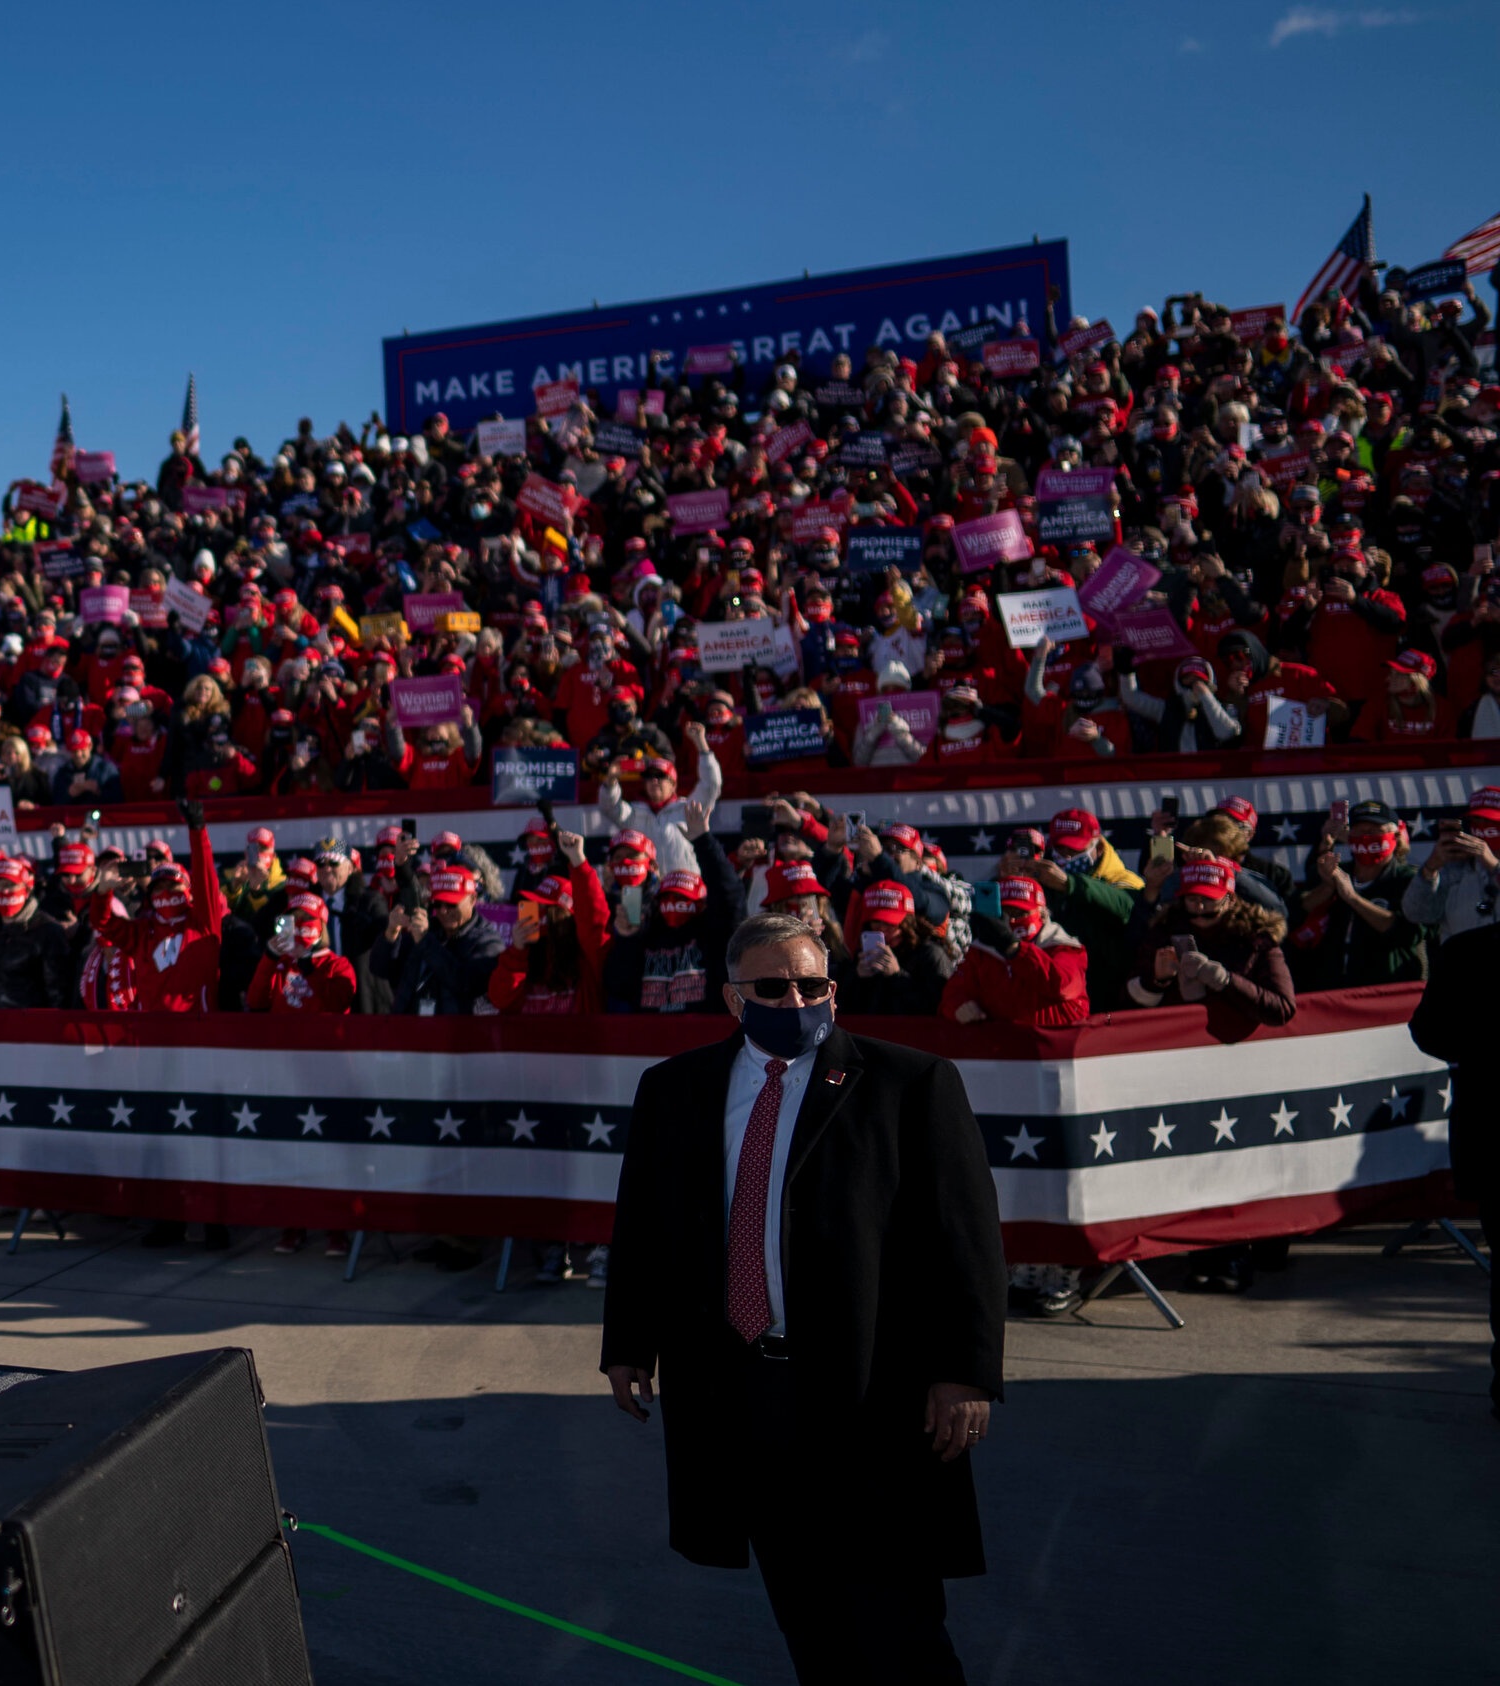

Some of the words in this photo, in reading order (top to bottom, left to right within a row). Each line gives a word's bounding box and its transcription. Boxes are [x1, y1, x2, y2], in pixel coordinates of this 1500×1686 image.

[416, 369, 515, 405] MAKE
[531, 350, 676, 389] AMERIC
[731, 321, 856, 364] GREAT
[875, 299, 1028, 345] AGAIN!
[675, 502, 722, 516] Women
[1056, 503, 1087, 512] MAKE
[794, 513, 847, 528] AMERICA
[1039, 511, 1108, 528] AMERICA
[850, 536, 921, 549] PROMISES
[962, 526, 1016, 549] Women
[862, 549, 905, 561] MADE
[1088, 561, 1138, 612] Women
[1023, 600, 1052, 610] MAKE
[1009, 605, 1078, 625] AMERICA
[720, 628, 749, 638] MAKE
[1012, 625, 1043, 636] GREAT
[1046, 619, 1082, 633] AGAIN
[1125, 624, 1176, 642] Women
[703, 635, 771, 652] AMERICA
[397, 690, 455, 706] Women
[765, 716, 798, 727] MAKE
[750, 723, 821, 745] AMERICA
[786, 736, 824, 750] AGAIN
[494, 761, 576, 777] PROMISES
[514, 776, 556, 791] KEPT
[613, 864, 647, 877] MAGA
[152, 894, 187, 909] MAGA
